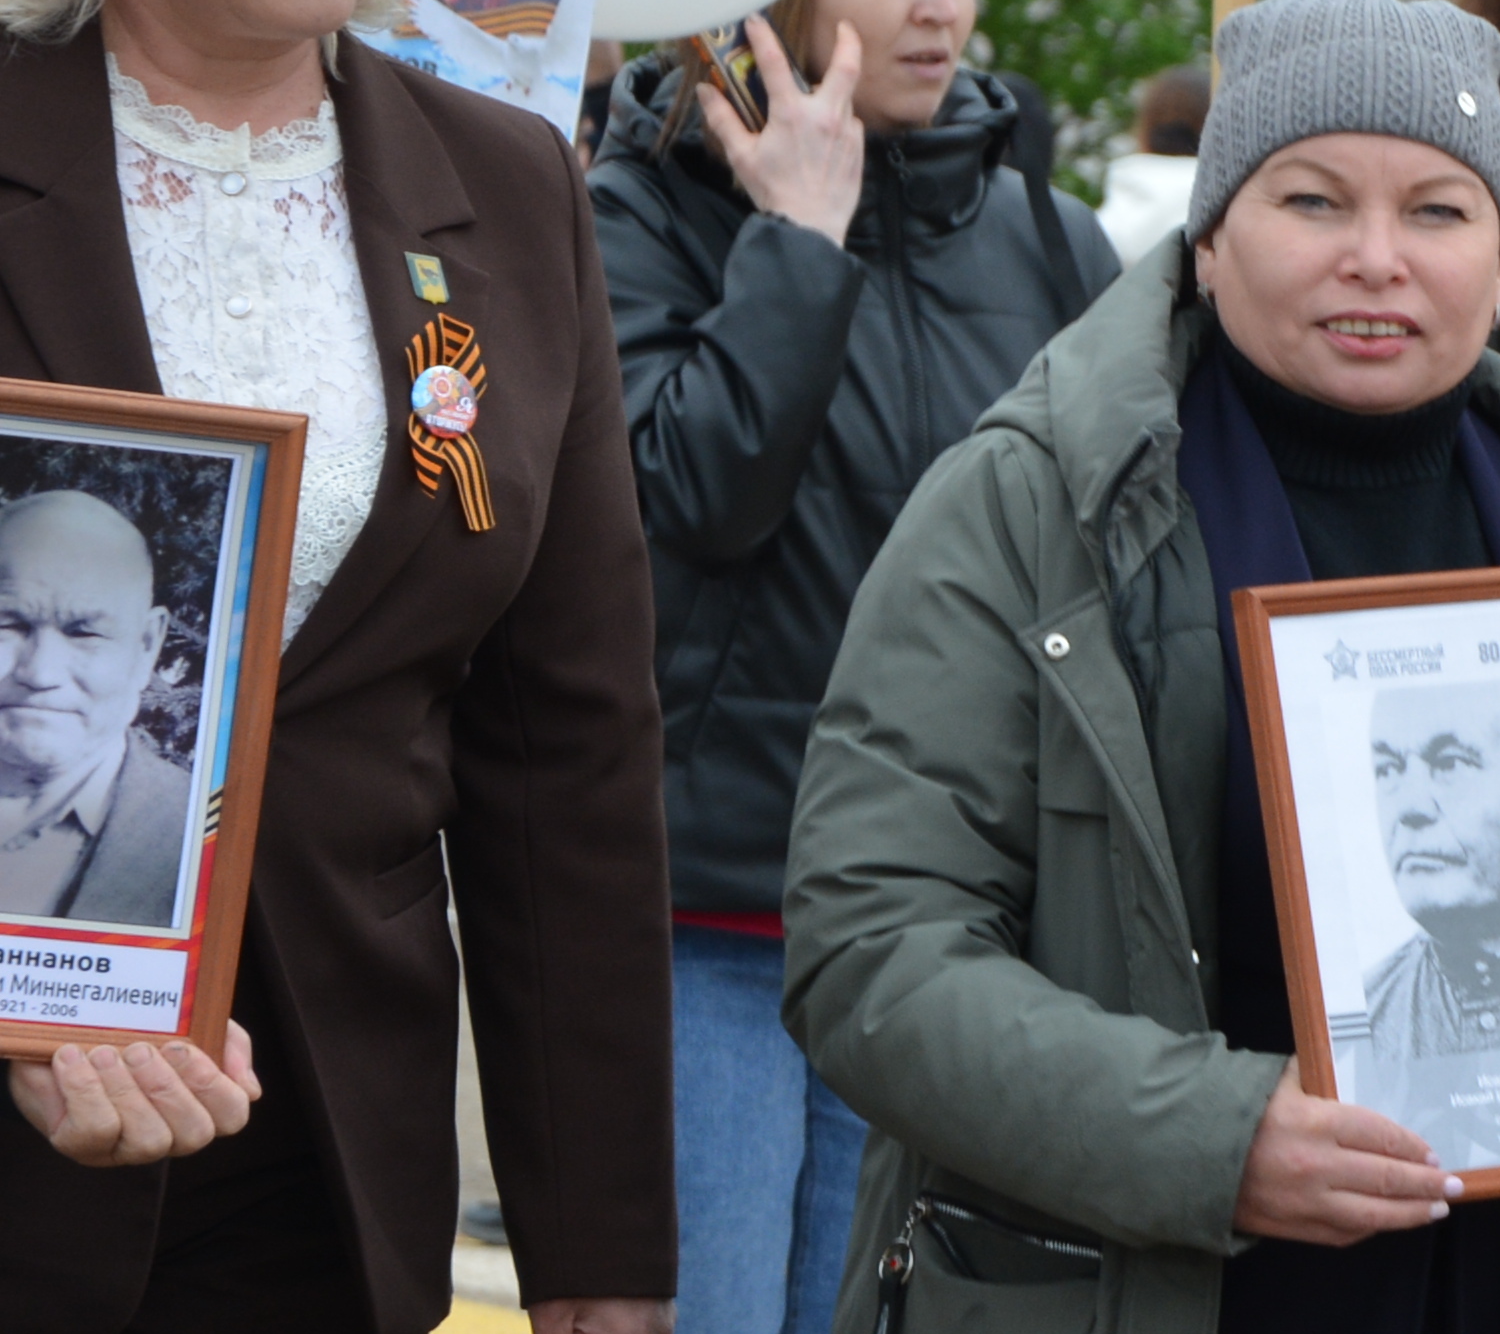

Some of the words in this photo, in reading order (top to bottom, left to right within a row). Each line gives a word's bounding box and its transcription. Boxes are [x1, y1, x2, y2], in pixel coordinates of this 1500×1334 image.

[1478, 641, 1500, 663] 80
[10, 974, 177, 1008] Миннегалиевич
[40, 1002, 78, 1017] 2006
